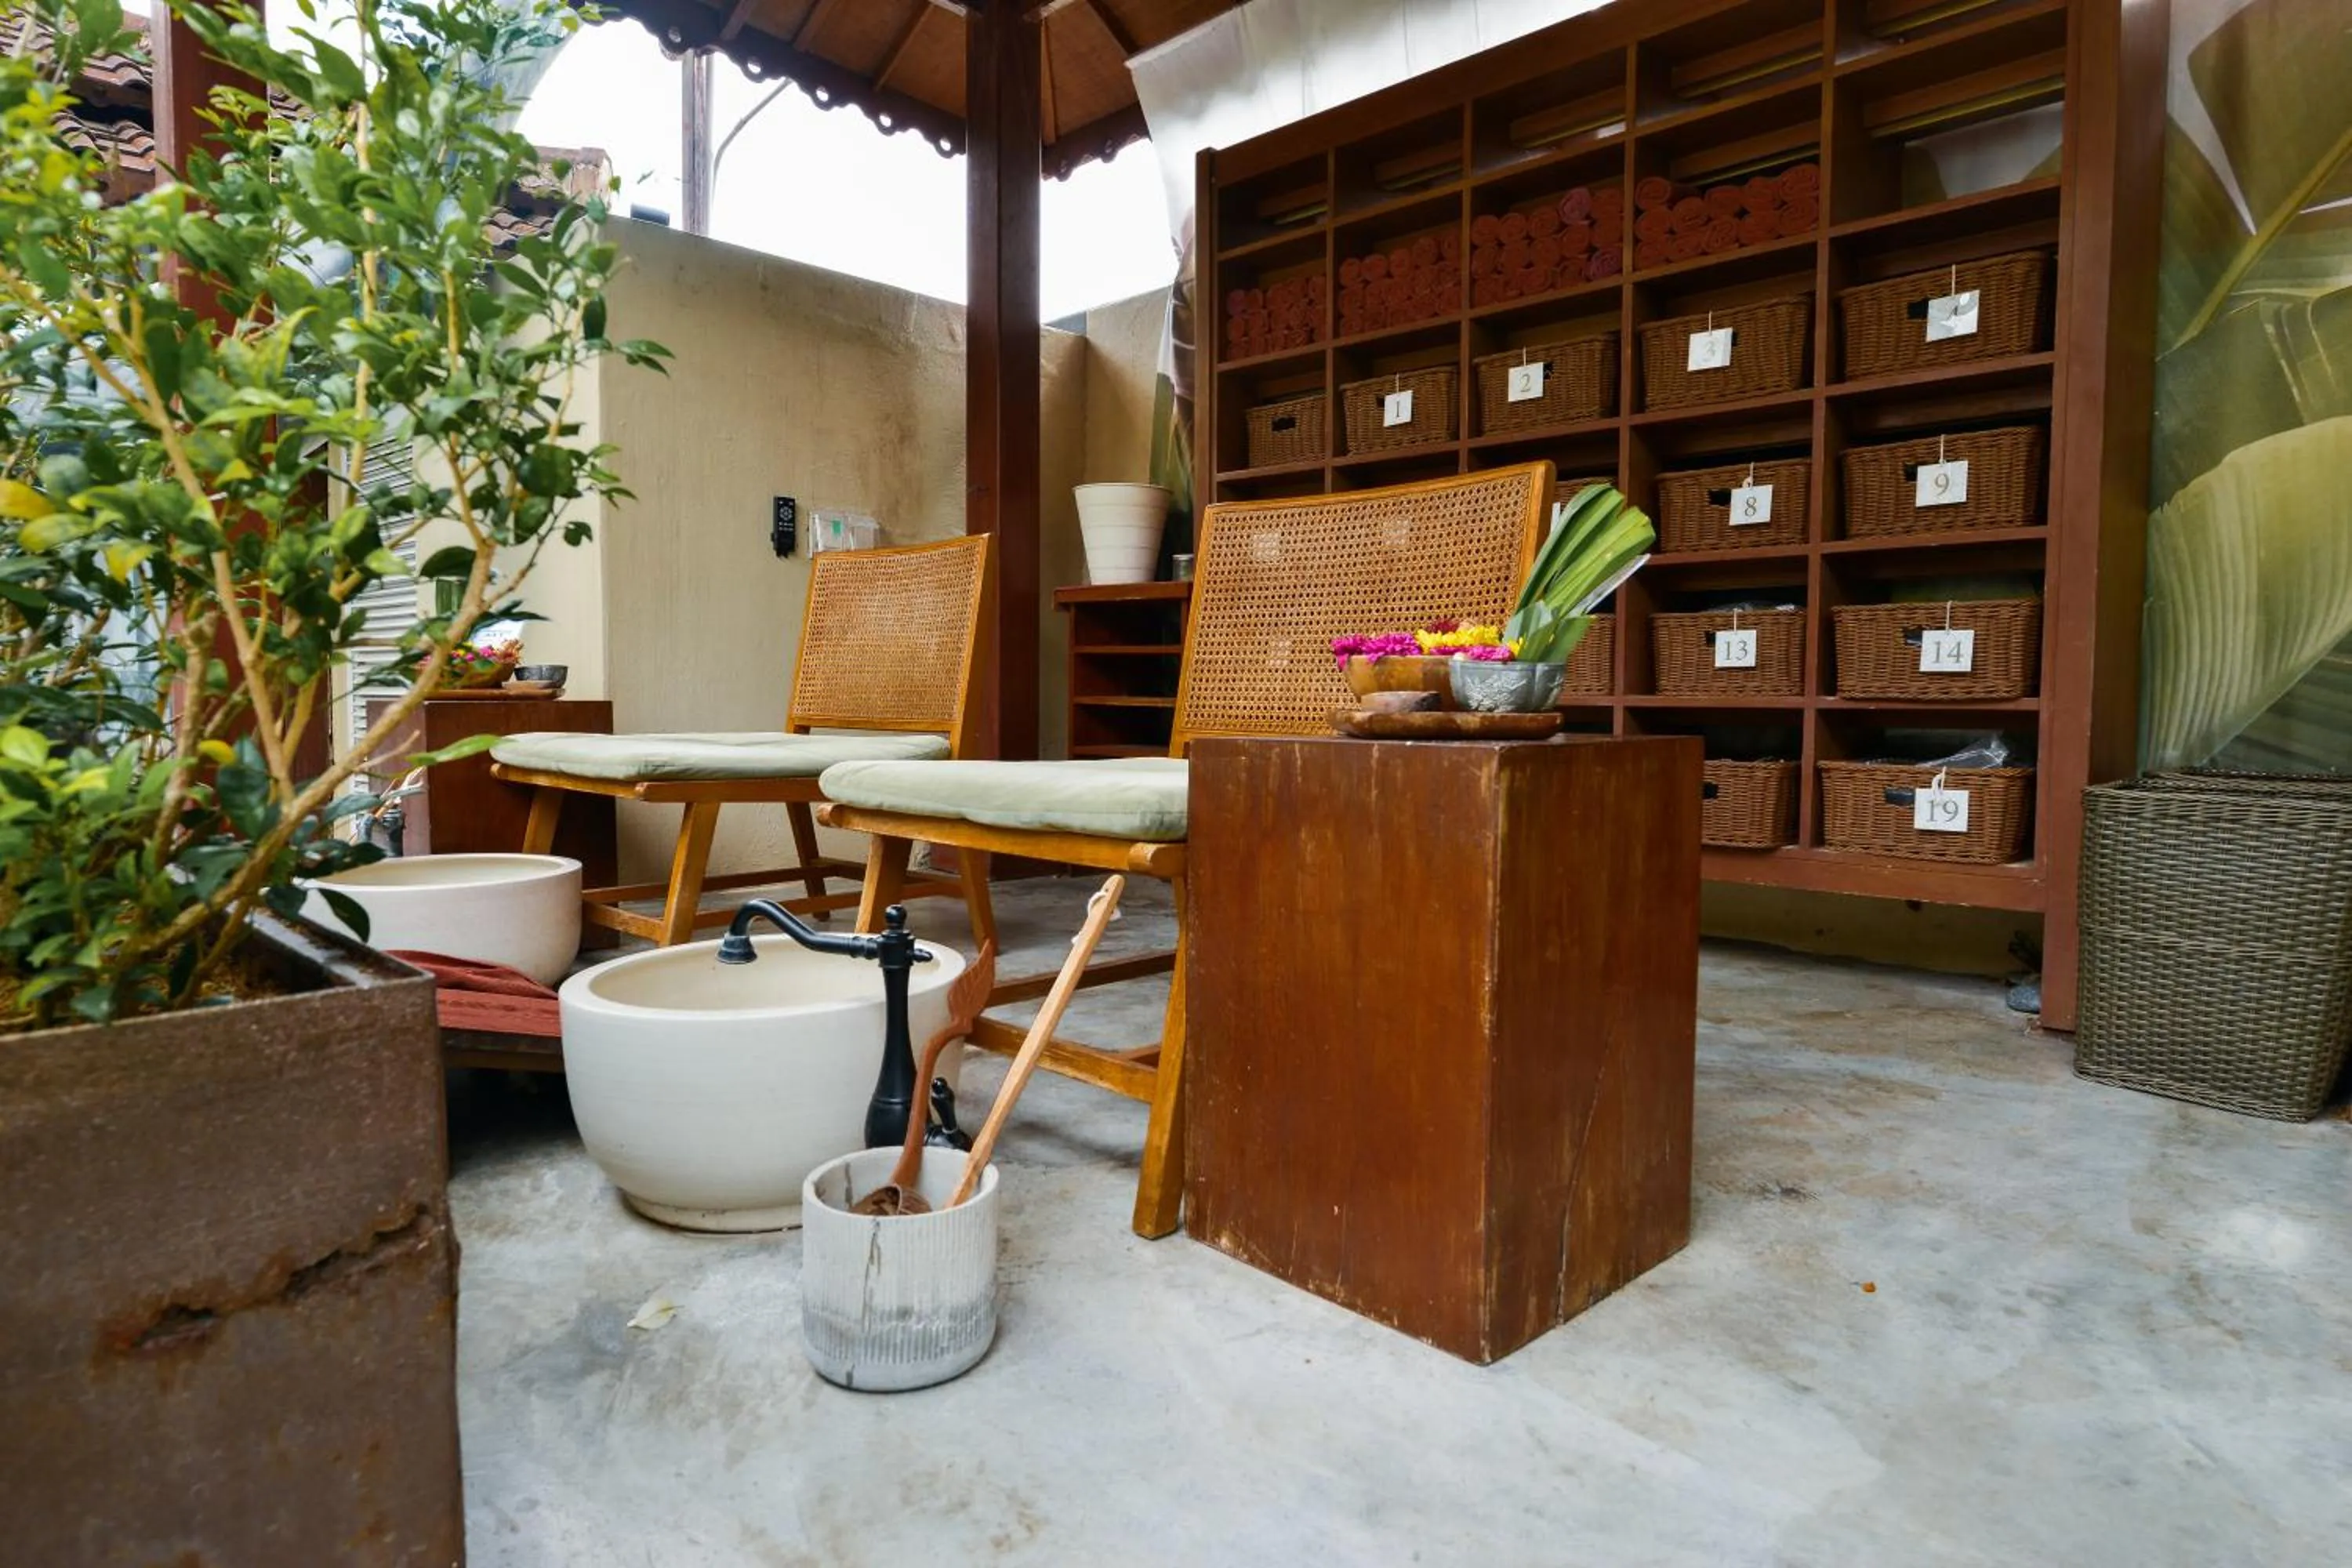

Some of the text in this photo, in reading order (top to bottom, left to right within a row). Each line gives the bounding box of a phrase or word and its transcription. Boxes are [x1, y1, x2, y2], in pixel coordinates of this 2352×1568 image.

[1519, 373, 1531, 394] 2
[1395, 401, 1401, 418] 1
[1934, 472, 1950, 496] 9
[1744, 495, 1757, 517] 8
[1725, 640, 1748, 661] 13
[1933, 640, 1964, 664] 14
[1926, 799, 1959, 823] 19
